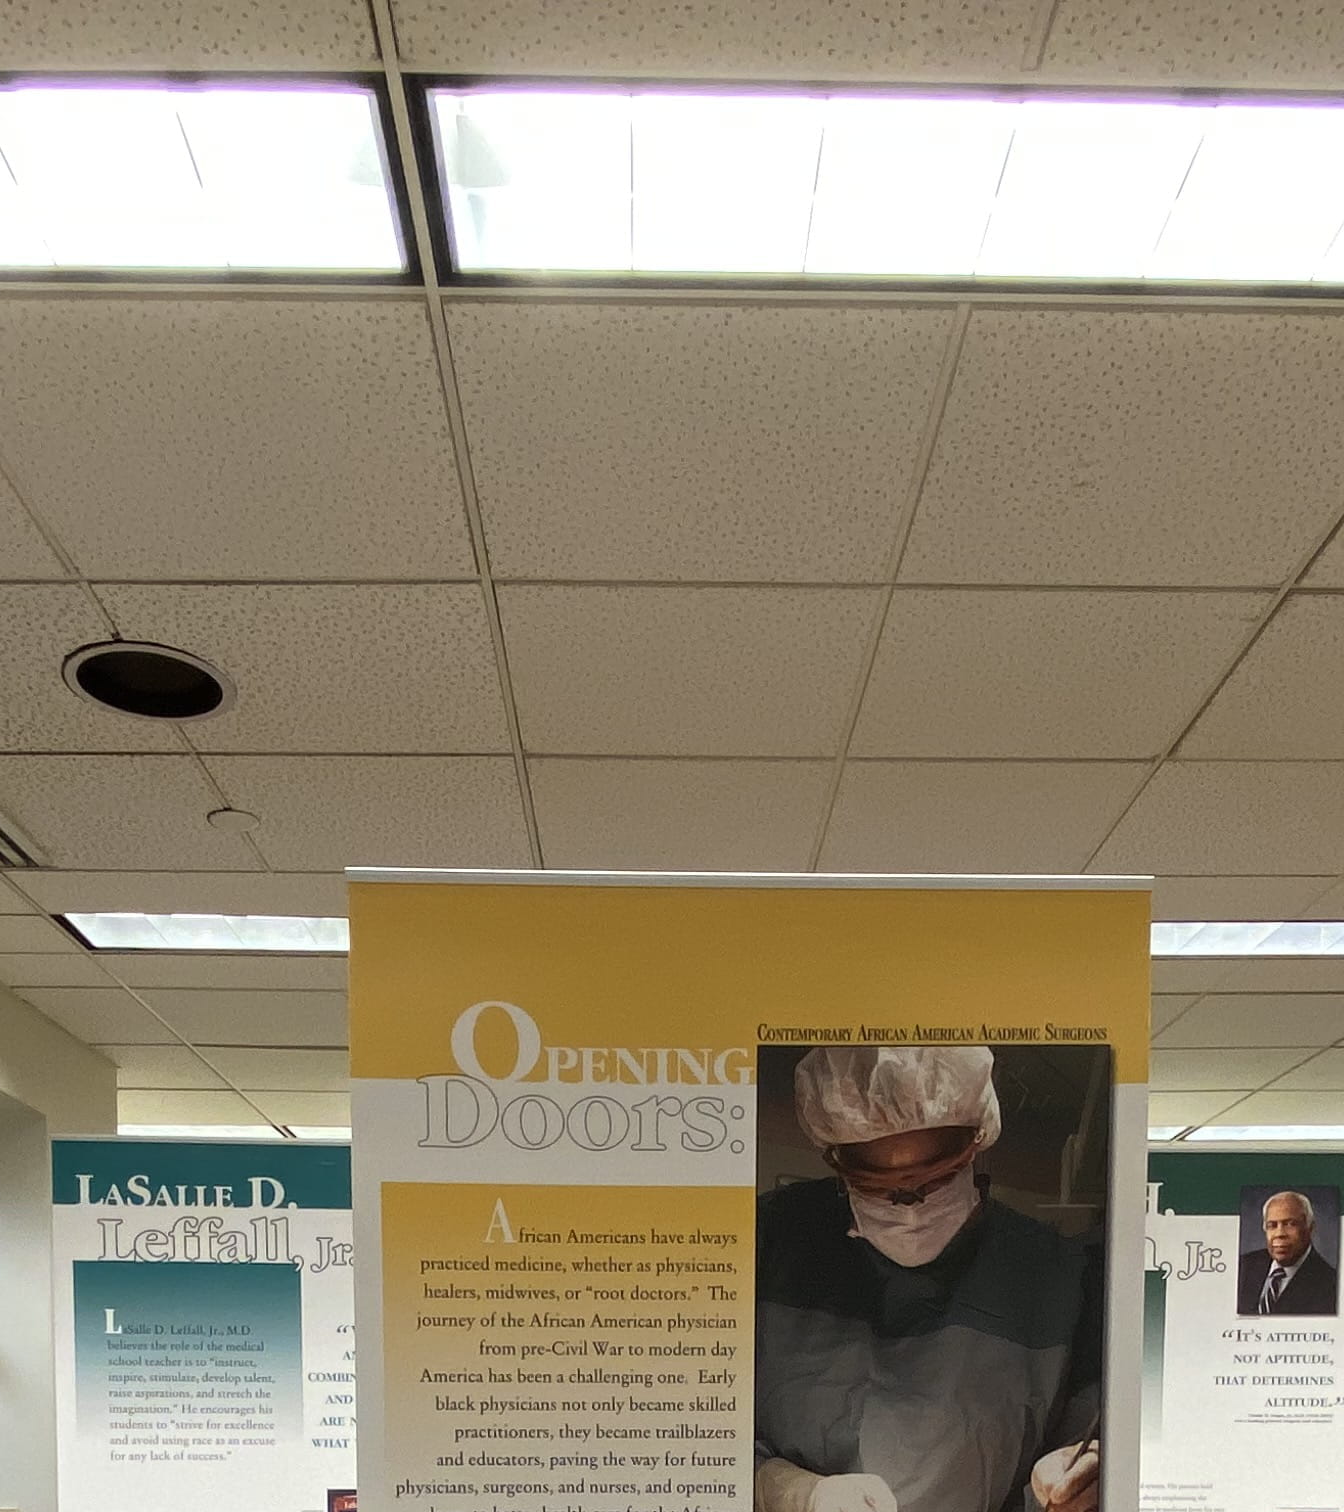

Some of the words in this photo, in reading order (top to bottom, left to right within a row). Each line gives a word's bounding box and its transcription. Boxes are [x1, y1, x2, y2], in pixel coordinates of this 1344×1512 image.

[756, 1023, 853, 1042] CONTEMPORARY
[857, 1023, 907, 1042] AFRICAN
[911, 1023, 974, 1041] AMERICAN
[977, 1023, 1040, 1041] ACADEMIC
[1044, 1022, 1107, 1041] SURGEONS
[451, 1000, 754, 1087] OPENING
[415, 1073, 746, 1154] Doors:
[74, 1173, 236, 1208] LASALLE
[247, 1176, 299, 1209] D.
[483, 1197, 561, 1244] African
[566, 1228, 646, 1244] Americans
[650, 1227, 684, 1244] have
[688, 1227, 737, 1249] always
[96, 1215, 305, 1273] Leffall,
[420, 1254, 490, 1275] practiced
[494, 1255, 567, 1274] medicine,
[571, 1255, 633, 1272] whether
[636, 1262, 651, 1272] as
[655, 1256, 737, 1277] physicians,
[1176, 1240, 1227, 1281] Jr.
[423, 1282, 481, 1301] healers,
[484, 1283, 560, 1302] midwives,
[564, 1289, 582, 1300] or
[585, 1285, 625, 1300] "root
[630, 1284, 699, 1301] doctors."
[706, 1284, 737, 1301] The
[416, 1311, 476, 1331] journey
[479, 1311, 497, 1327] of
[500, 1311, 525, 1328] the
[528, 1311, 585, 1328] African
[589, 1313, 662, 1328] American
[667, 1312, 737, 1333] physician
[1222, 1328, 1261, 1342] "IT'S
[1266, 1332, 1334, 1344] ATTITUDE,
[479, 1338, 516, 1356] from
[521, 1339, 588, 1360] pre-Civil
[592, 1340, 624, 1356] War
[628, 1345, 644, 1356] to
[648, 1340, 706, 1356] modern
[710, 1340, 737, 1361] day
[1233, 1354, 1261, 1364] NOT
[1265, 1354, 1334, 1366] APTITUDE,
[419, 1367, 483, 1383] America
[487, 1367, 512, 1383] has
[517, 1367, 552, 1383] been
[556, 1373, 564, 1383] a
[568, 1367, 653, 1388] challenging
[656, 1373, 688, 1384] one.
[698, 1368, 736, 1388] Early
[1215, 1375, 1247, 1385] THAT
[1252, 1375, 1334, 1386] DETERMINES
[325, 1394, 353, 1404] AND
[435, 1395, 476, 1411] black
[479, 1395, 557, 1416] physicians
[561, 1400, 587, 1411] not
[591, 1395, 625, 1415] only
[629, 1395, 684, 1412] became
[688, 1395, 736, 1412] skilled
[319, 1416, 344, 1426] ARE
[311, 1438, 349, 1448] WHAT
[454, 1423, 554, 1443] practitioners,
[558, 1423, 591, 1443] they
[595, 1423, 651, 1439] became
[655, 1423, 736, 1439] trailblazers
[436, 1450, 464, 1466] and
[468, 1450, 545, 1468] educators,
[549, 1451, 598, 1470] paving
[602, 1450, 626, 1466] the
[630, 1456, 660, 1470] way
[664, 1450, 686, 1466] for
[691, 1450, 736, 1467] future
[395, 1478, 478, 1498] physicians,
[482, 1483, 553, 1498] surgeons,
[557, 1477, 584, 1494] and
[589, 1483, 640, 1496] nurses,
[644, 1477, 672, 1494] and
[676, 1479, 736, 1498] opening
